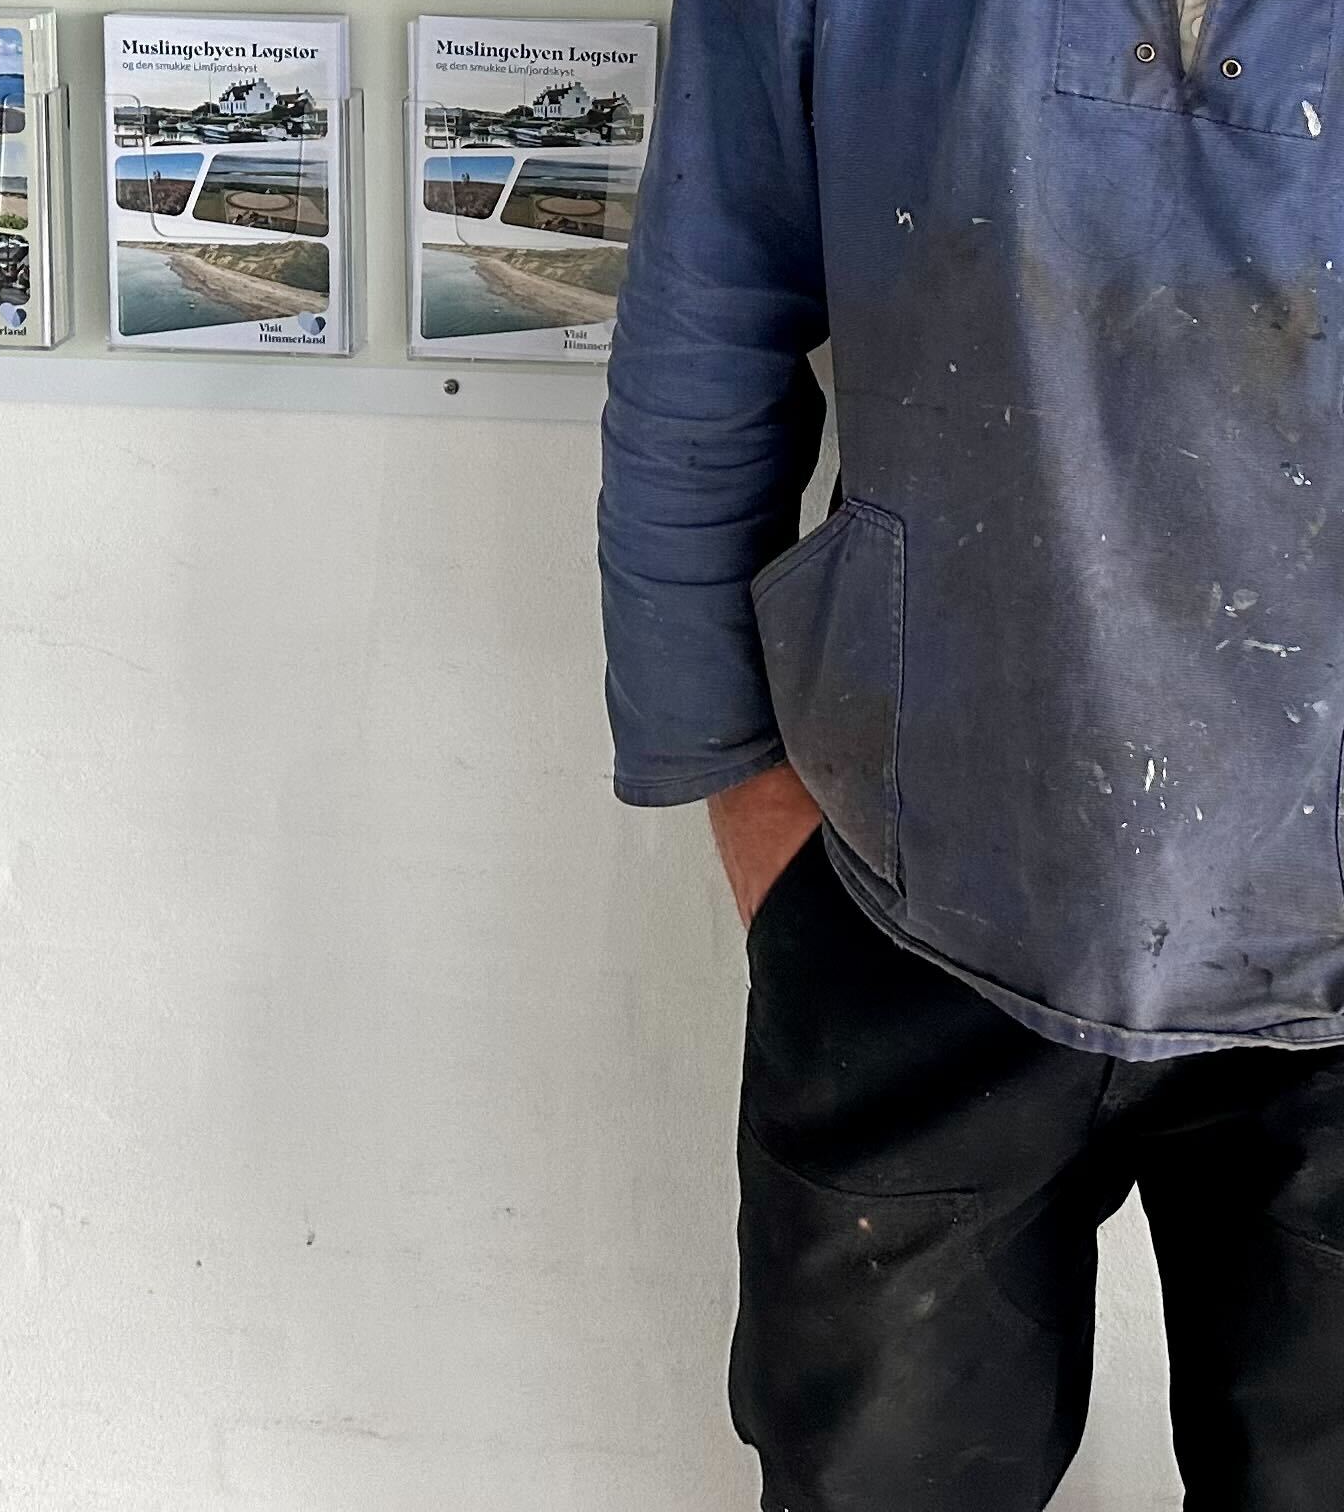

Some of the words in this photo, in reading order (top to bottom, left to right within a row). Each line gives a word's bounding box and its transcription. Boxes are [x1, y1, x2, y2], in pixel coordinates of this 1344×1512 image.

[122, 39, 246, 60] Muslingebyen
[251, 43, 318, 62] Løgstør
[436, 39, 563, 63] Muslingebyen
[568, 46, 638, 66] Løgstør
[122, 61, 134, 70] og
[135, 61, 153, 70] den
[154, 62, 191, 71] smukke
[193, 62, 258, 72] Limfjordskyst
[259, 323, 282, 332] Visit
[259, 334, 326, 345] Himmerland
